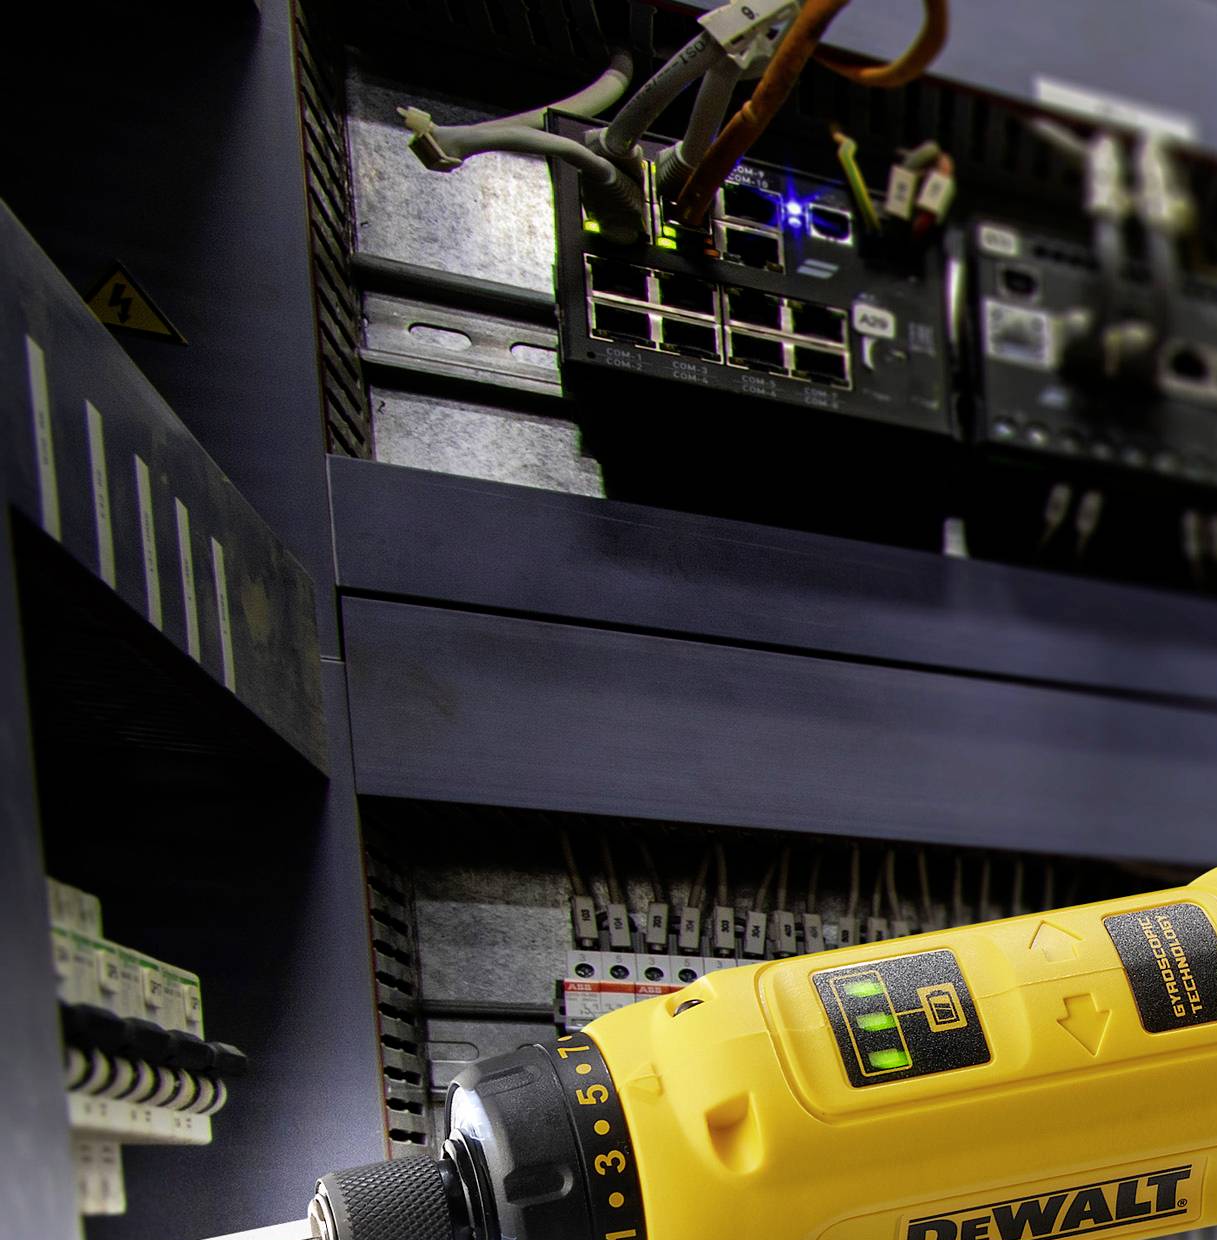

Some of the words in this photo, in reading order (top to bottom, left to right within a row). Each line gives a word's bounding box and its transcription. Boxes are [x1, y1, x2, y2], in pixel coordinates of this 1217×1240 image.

[605, 347, 643, 361] COM-1
[605, 356, 643, 371] COM-2
[672, 361, 708, 375] COM-3
[581, 909, 591, 921] 103
[613, 918, 623, 930] 104
[1139, 917, 1186, 1017] GYROSCOPIC
[1155, 915, 1203, 1014] TECHNOLOGY
[567, 983, 593, 991] ABB
[639, 986, 663, 994] ABB
[557, 1045, 590, 1059] 7
[576, 1083, 609, 1105] 5
[594, 1150, 626, 1176] 3
